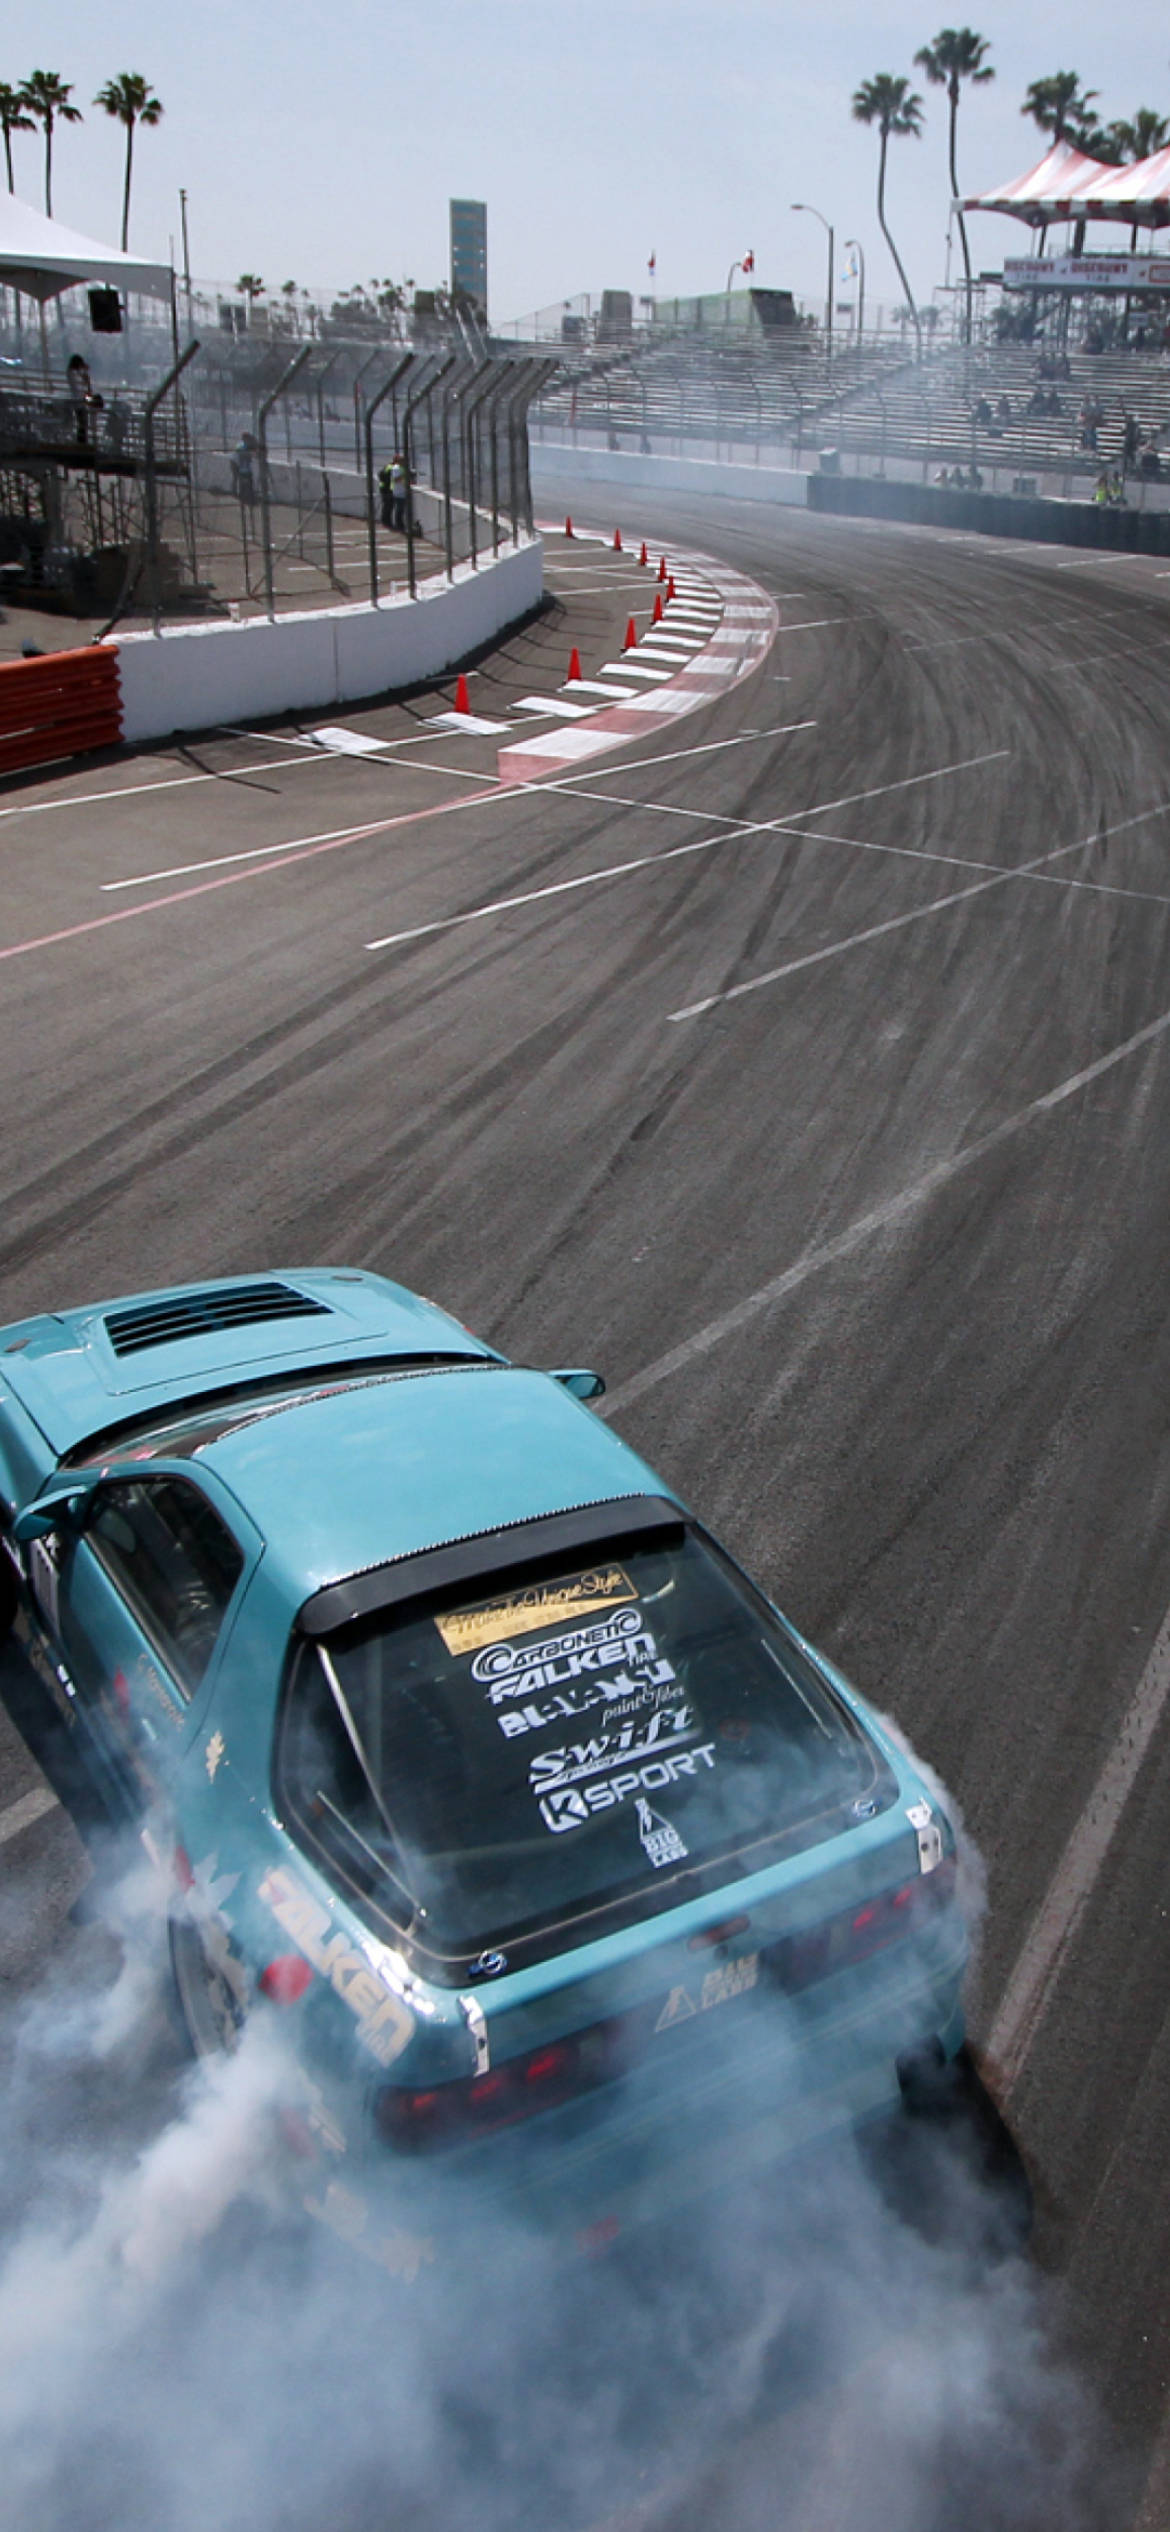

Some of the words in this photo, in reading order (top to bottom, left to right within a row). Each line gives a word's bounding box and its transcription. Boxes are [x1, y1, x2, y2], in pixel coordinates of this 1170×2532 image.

[1072, 262, 1128, 274] DISCOUNT
[471, 1608, 642, 1682] CARBONETIC
[486, 1633, 657, 1705] FALKEN
[257, 1866, 416, 2066] FALKEN
